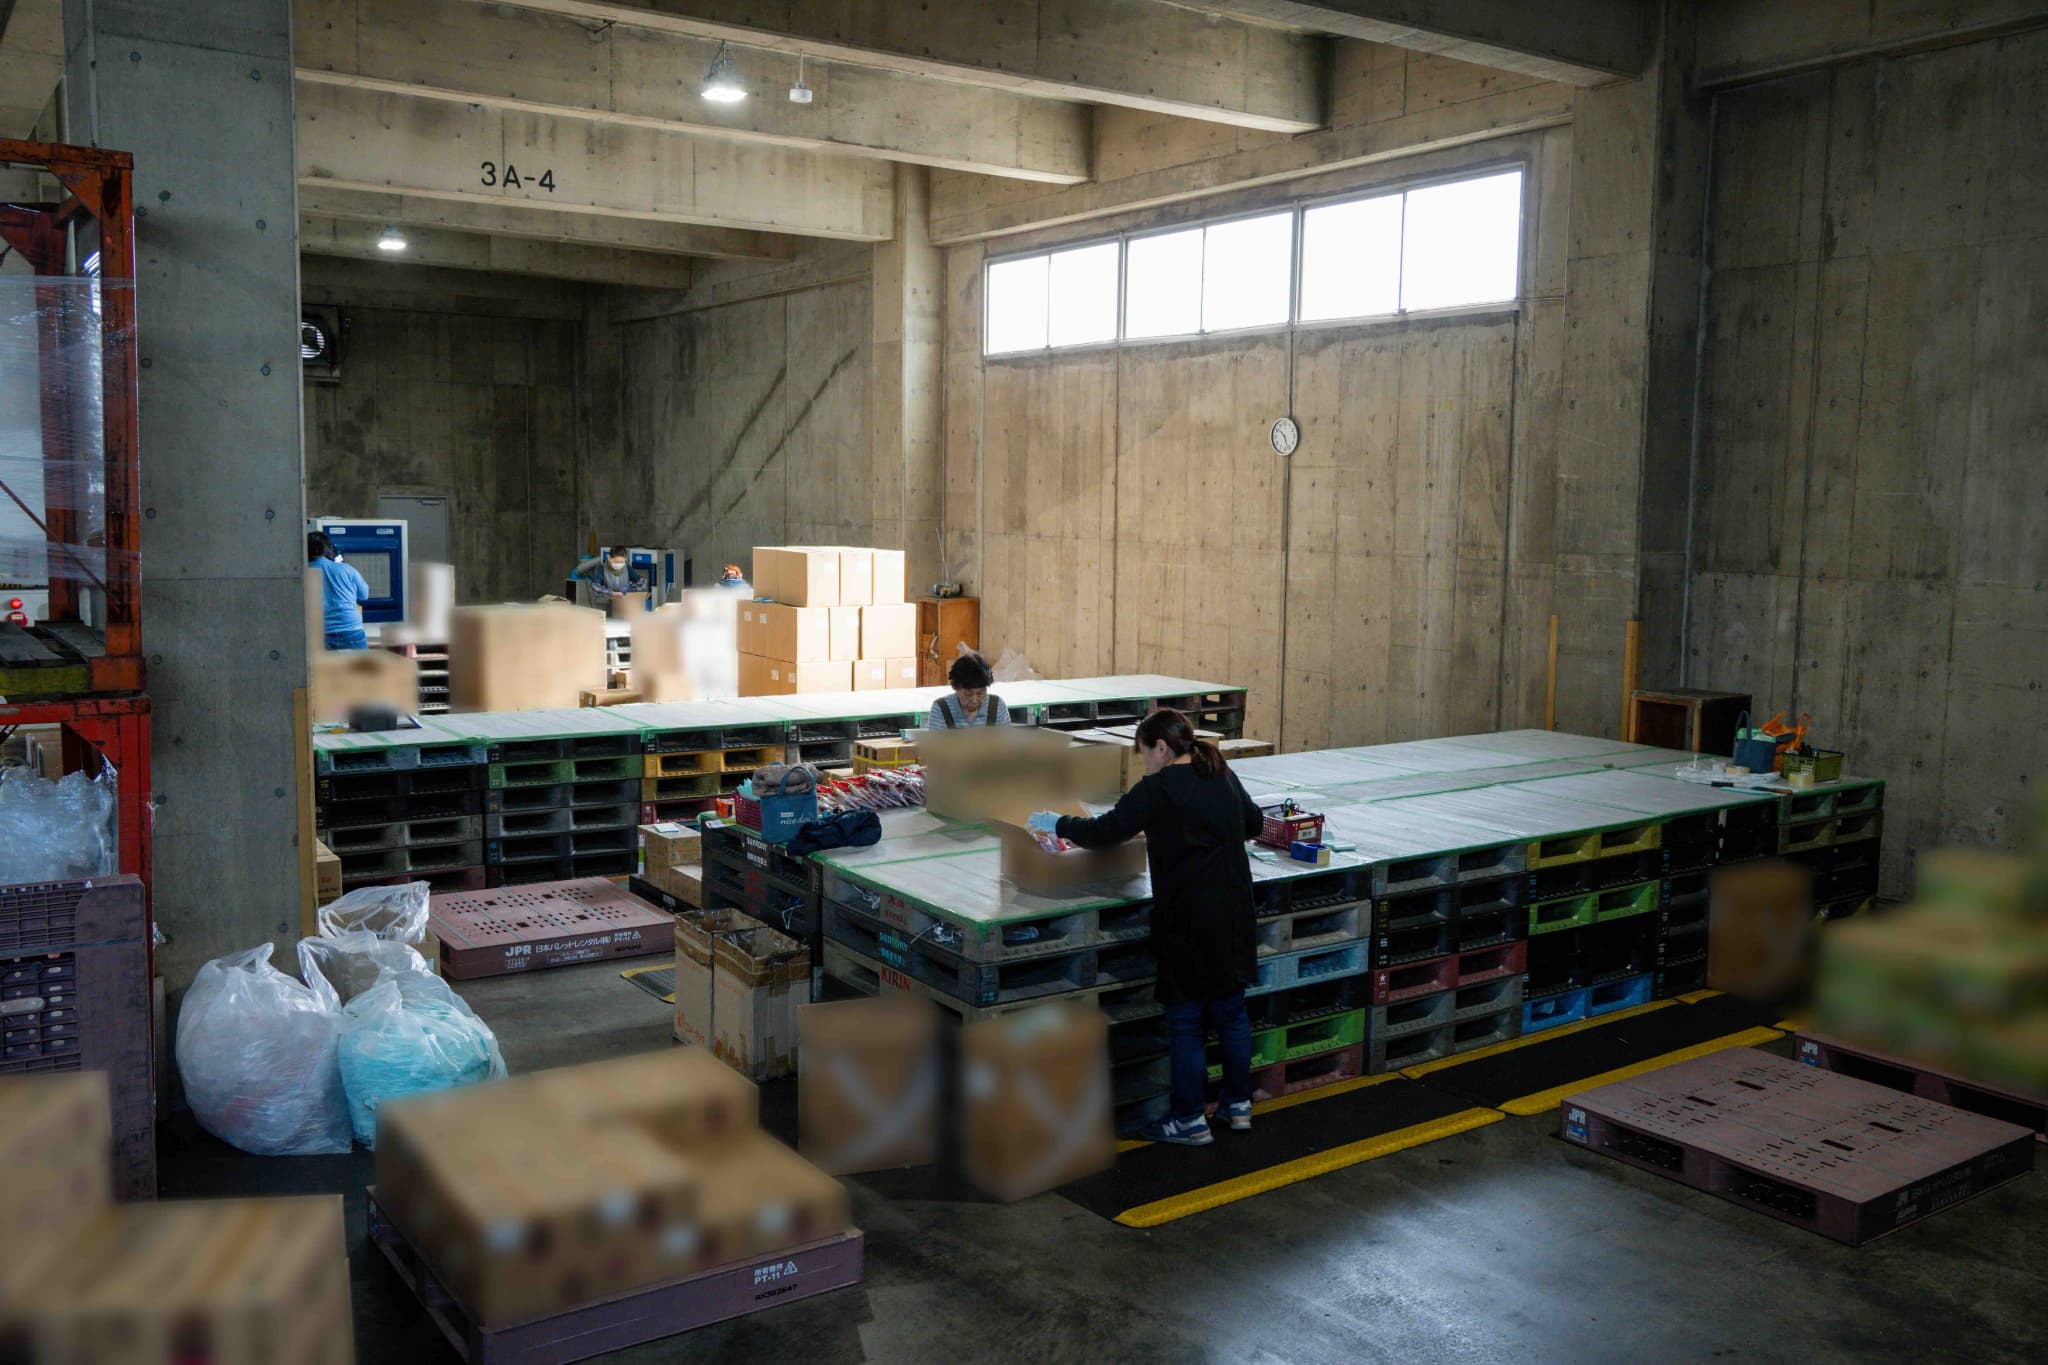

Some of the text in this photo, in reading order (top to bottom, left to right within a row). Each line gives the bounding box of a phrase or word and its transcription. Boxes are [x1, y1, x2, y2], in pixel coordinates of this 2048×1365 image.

[481, 161, 556, 193] 3A-4
[505, 944, 532, 957] JPR
[881, 966, 911, 992] KIRIN
[1802, 1041, 1818, 1056] JPR
[1568, 1107, 1586, 1125] JPR
[754, 1272, 781, 1285] PT-11
